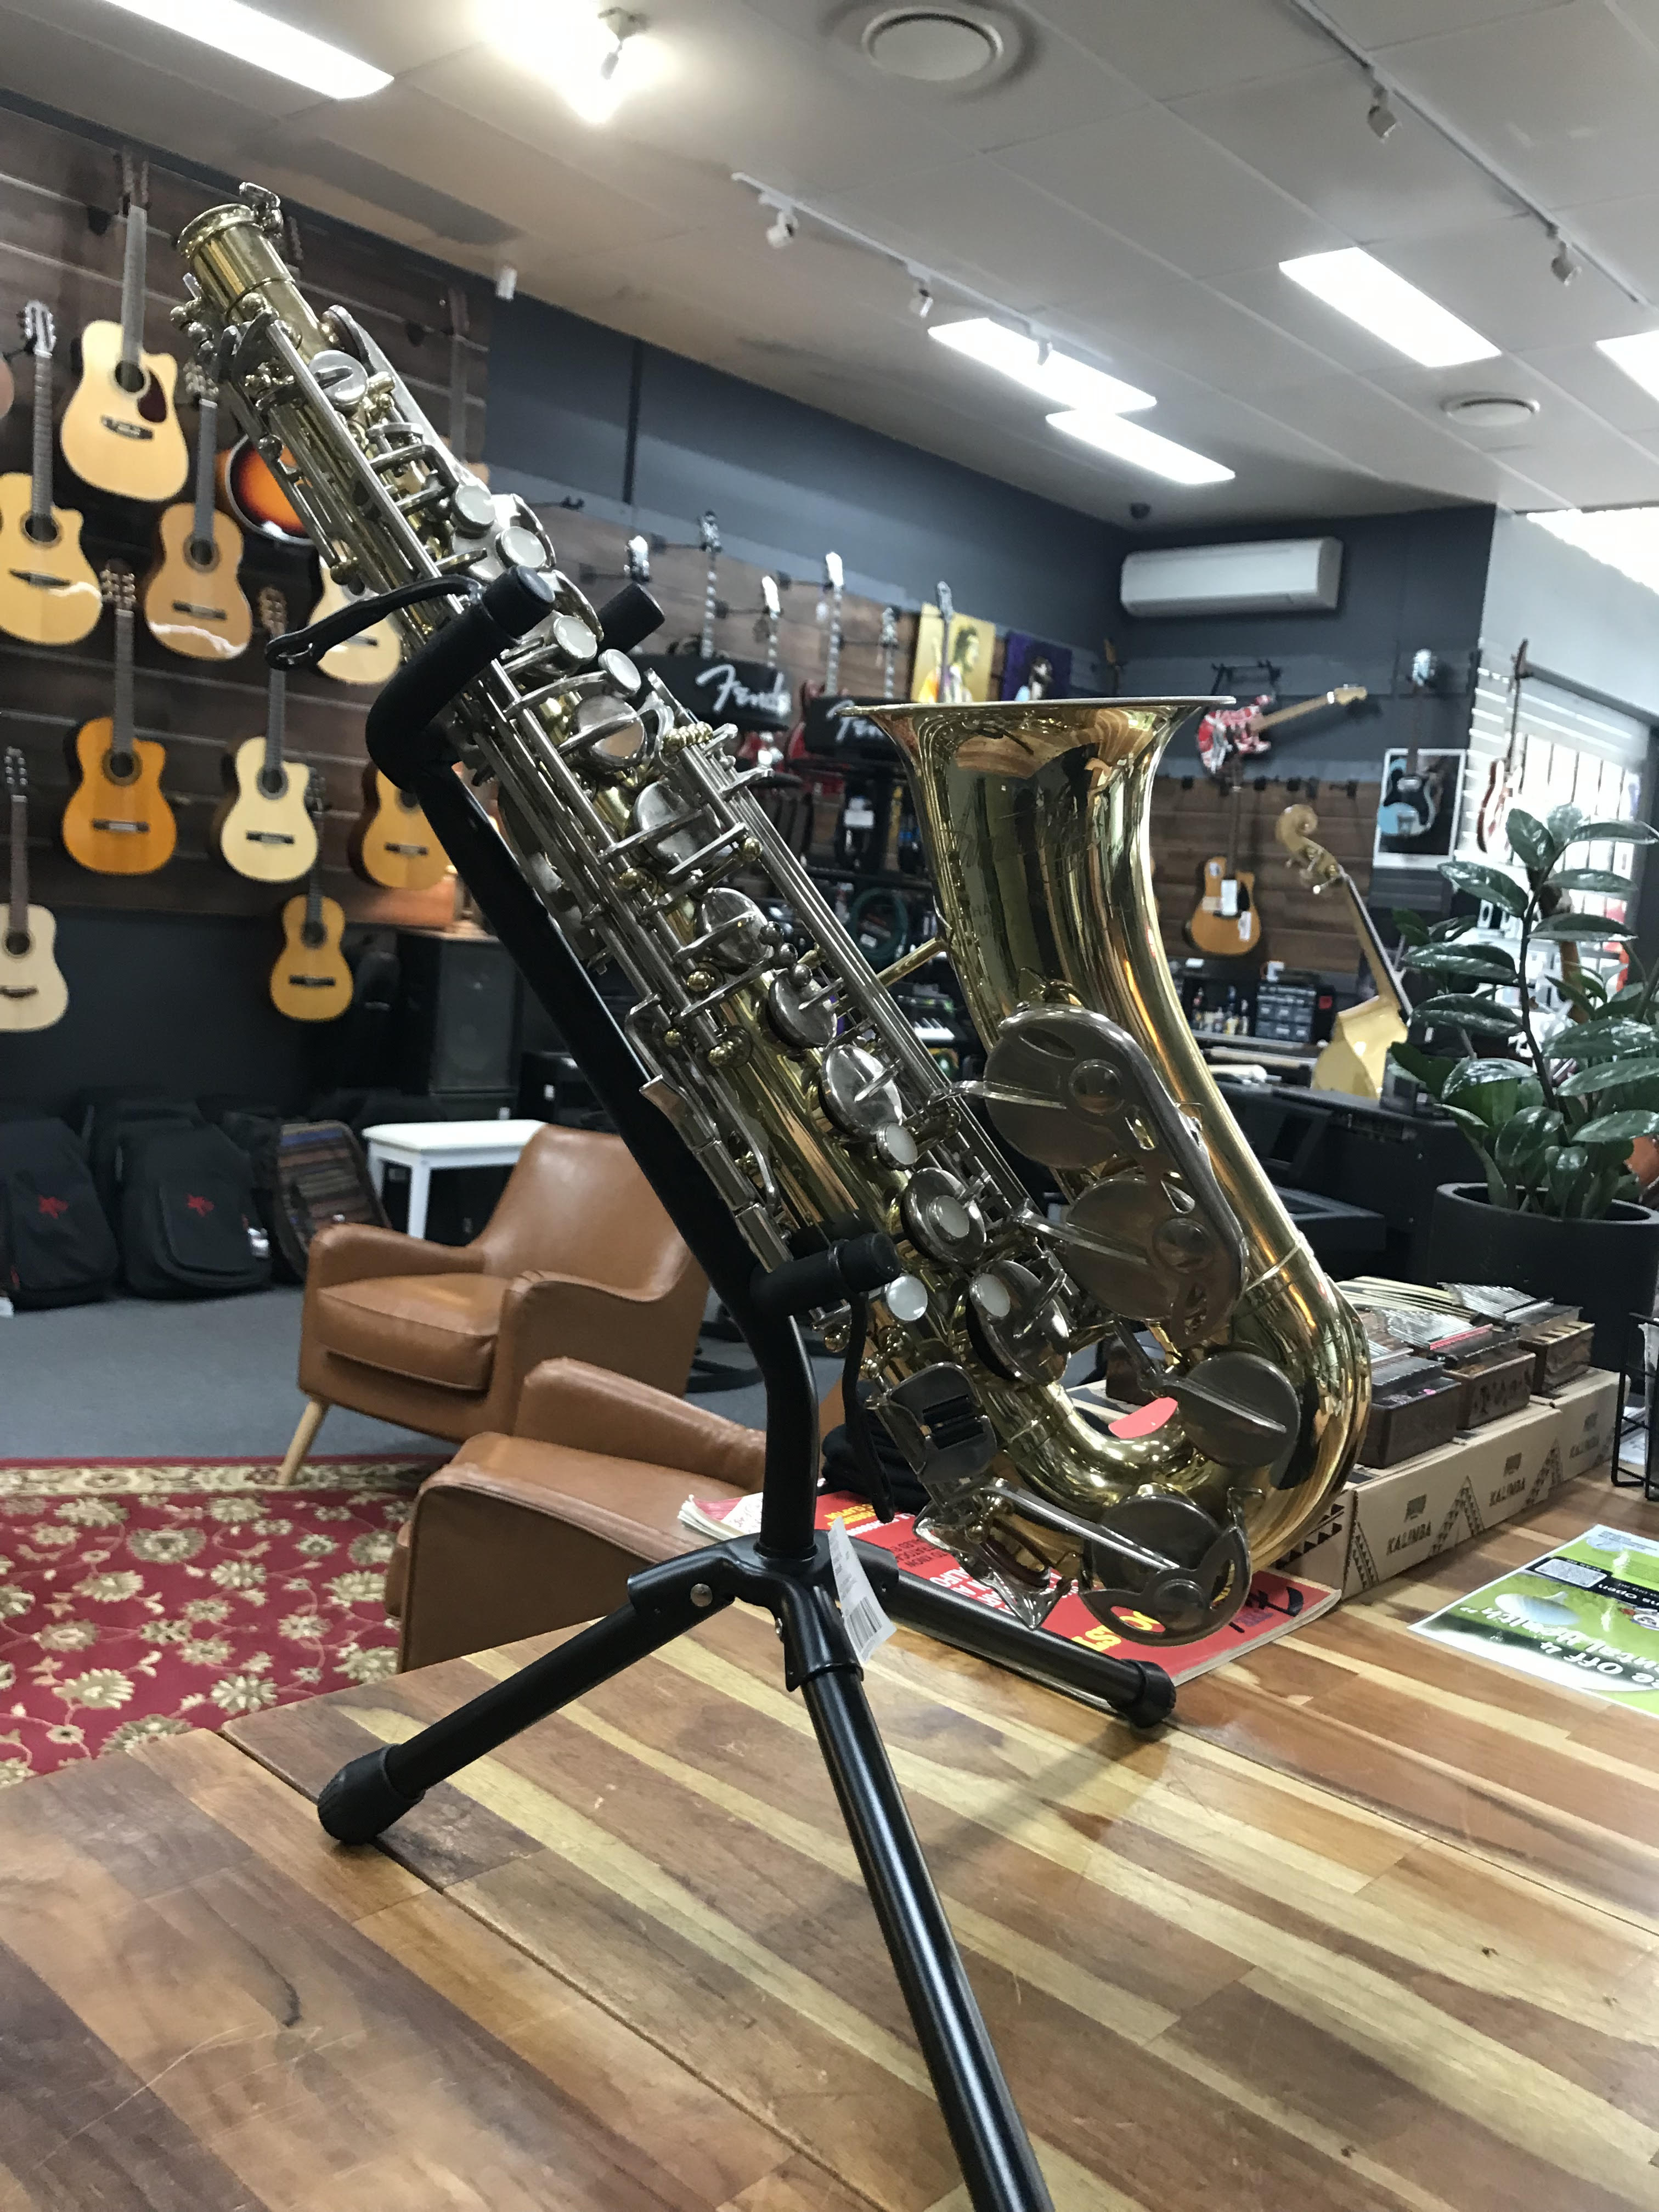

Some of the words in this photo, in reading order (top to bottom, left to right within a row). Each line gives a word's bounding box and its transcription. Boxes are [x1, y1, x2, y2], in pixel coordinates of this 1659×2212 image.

[1489, 1478, 1525, 1507] KALIMBA
[1386, 1520, 1431, 1556] KALIMBA
[1598, 1583, 1637, 1599] Open
[1540, 1641, 1562, 1655] 4
[1564, 1652, 1623, 1674] Off
